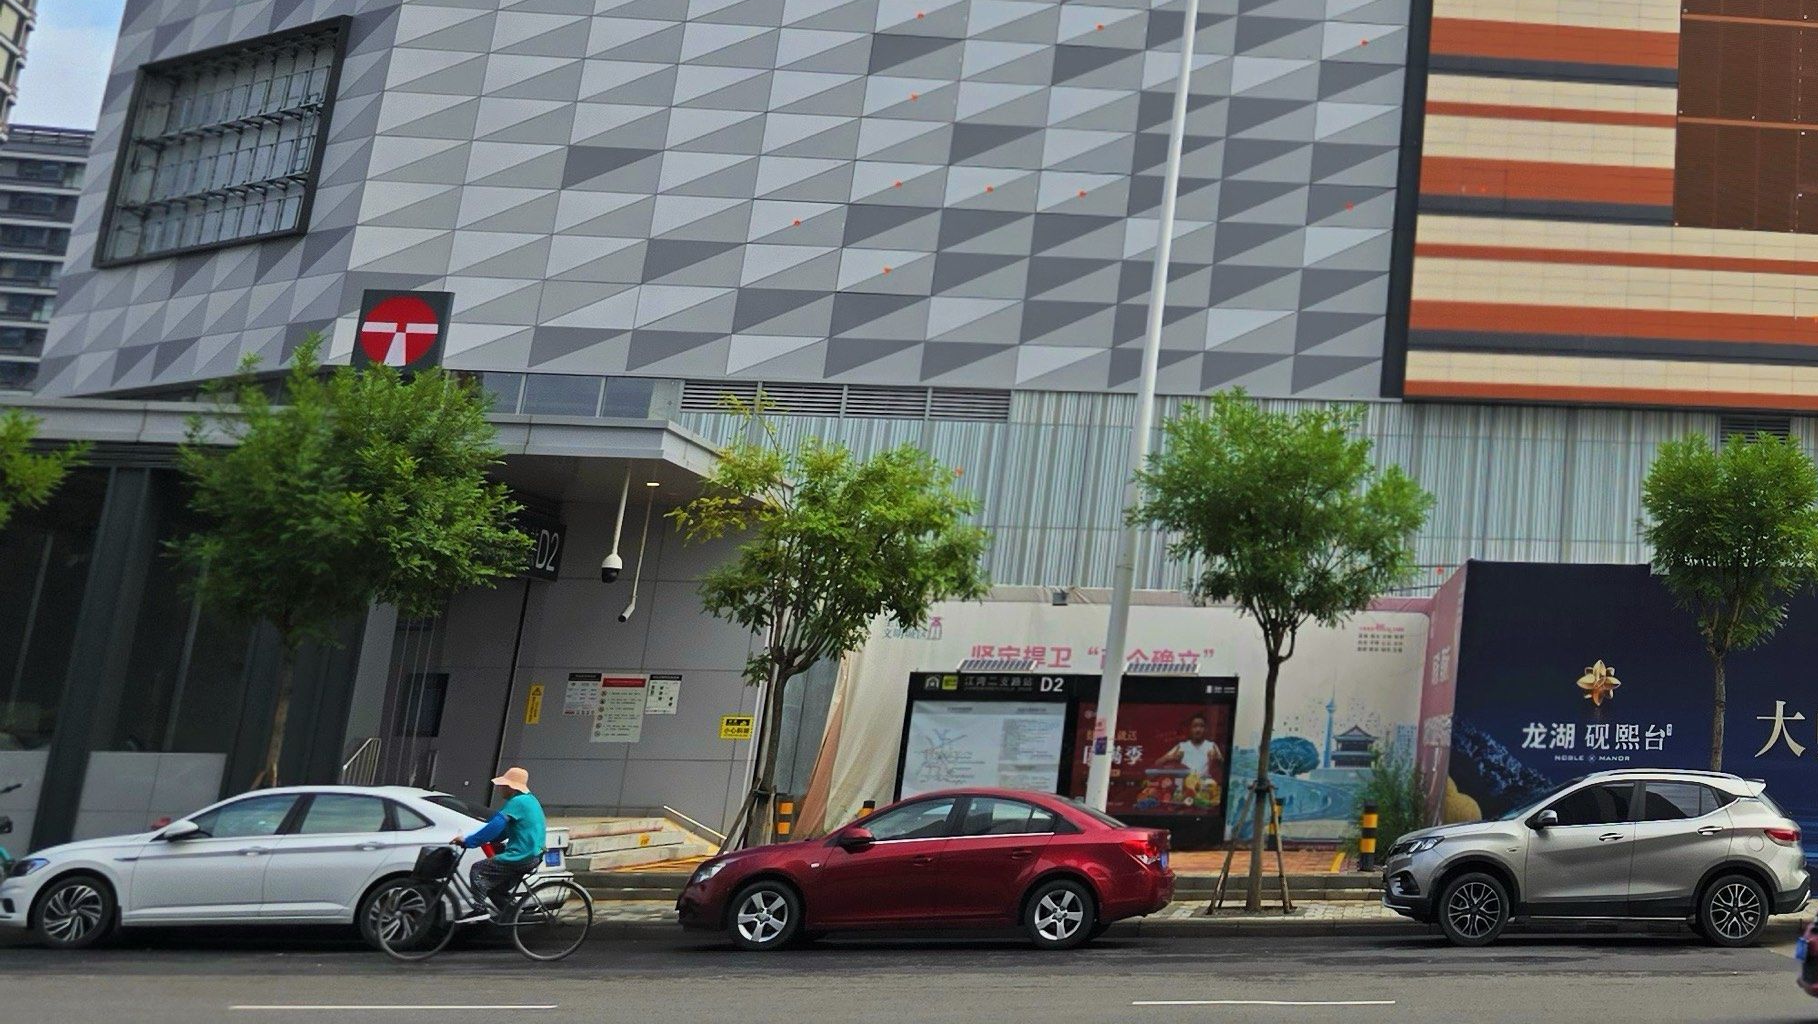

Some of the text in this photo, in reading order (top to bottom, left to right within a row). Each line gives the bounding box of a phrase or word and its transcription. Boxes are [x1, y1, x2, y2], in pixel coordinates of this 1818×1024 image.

[535, 529, 560, 572] D2
[1040, 677, 1064, 692] D2
[1521, 722, 1576, 749] 龙湖
